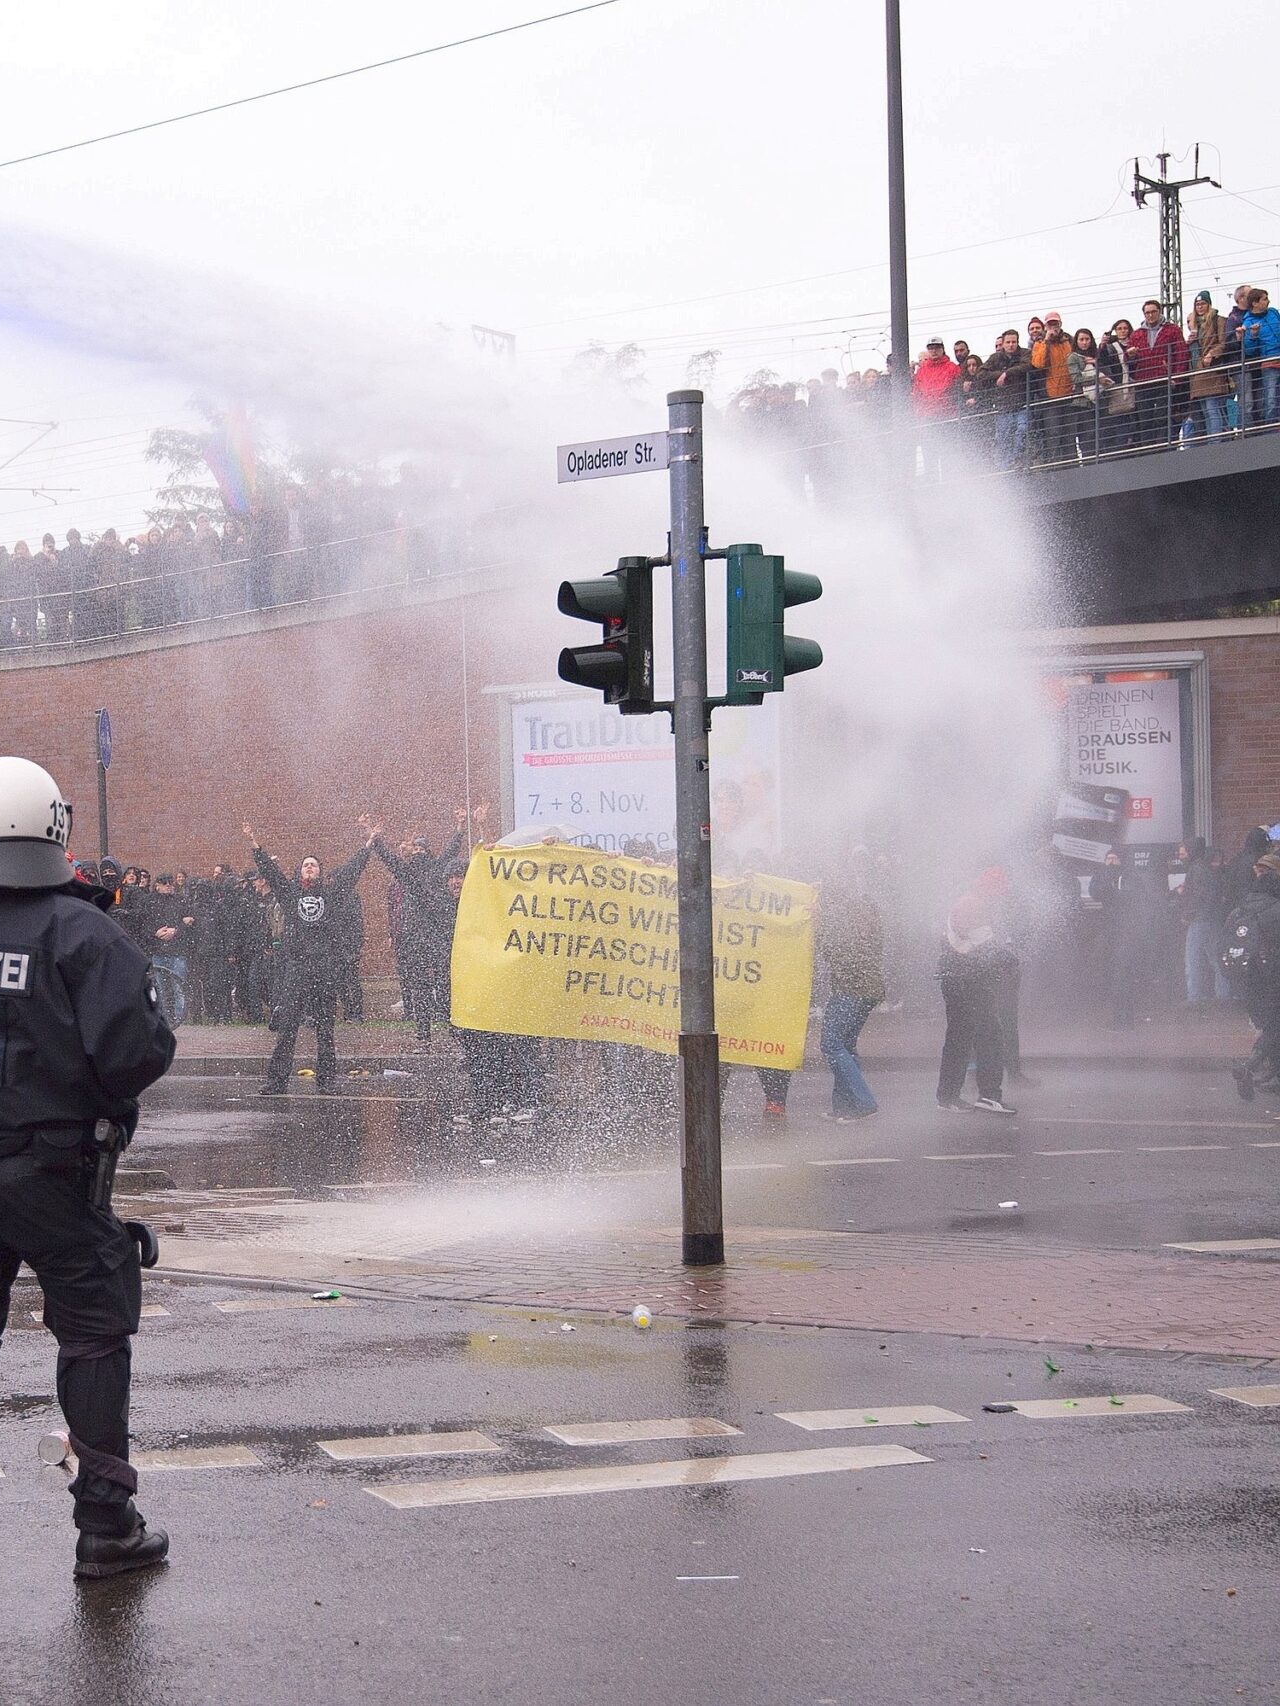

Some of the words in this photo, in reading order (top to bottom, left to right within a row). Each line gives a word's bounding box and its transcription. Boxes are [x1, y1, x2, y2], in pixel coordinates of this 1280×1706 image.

[567, 447, 628, 476] Opladener
[634, 442, 656, 464] Str.
[1077, 688, 1154, 705] DRINNEN
[1078, 704, 1129, 719] SPIELT
[1077, 720, 1104, 733] DIE
[1110, 717, 1163, 732] BAND.
[1078, 731, 1172, 747] DRAUSSEN
[1078, 748, 1107, 761] DIE
[1079, 761, 1138, 775] MUSIK.
[528, 794, 543, 815] 7.
[570, 791, 590, 814] 8.
[600, 790, 649, 813] Nov.
[1132, 800, 1151, 810] 6€
[50, 800, 65, 829] 13
[489, 856, 539, 881] WO
[547, 863, 716, 904] RASSISM
[723, 887, 792, 917] ZUM
[507, 894, 620, 925] ALLTAG
[717, 920, 765, 948] IST
[504, 928, 762, 984] ANTIFASCHIUS
